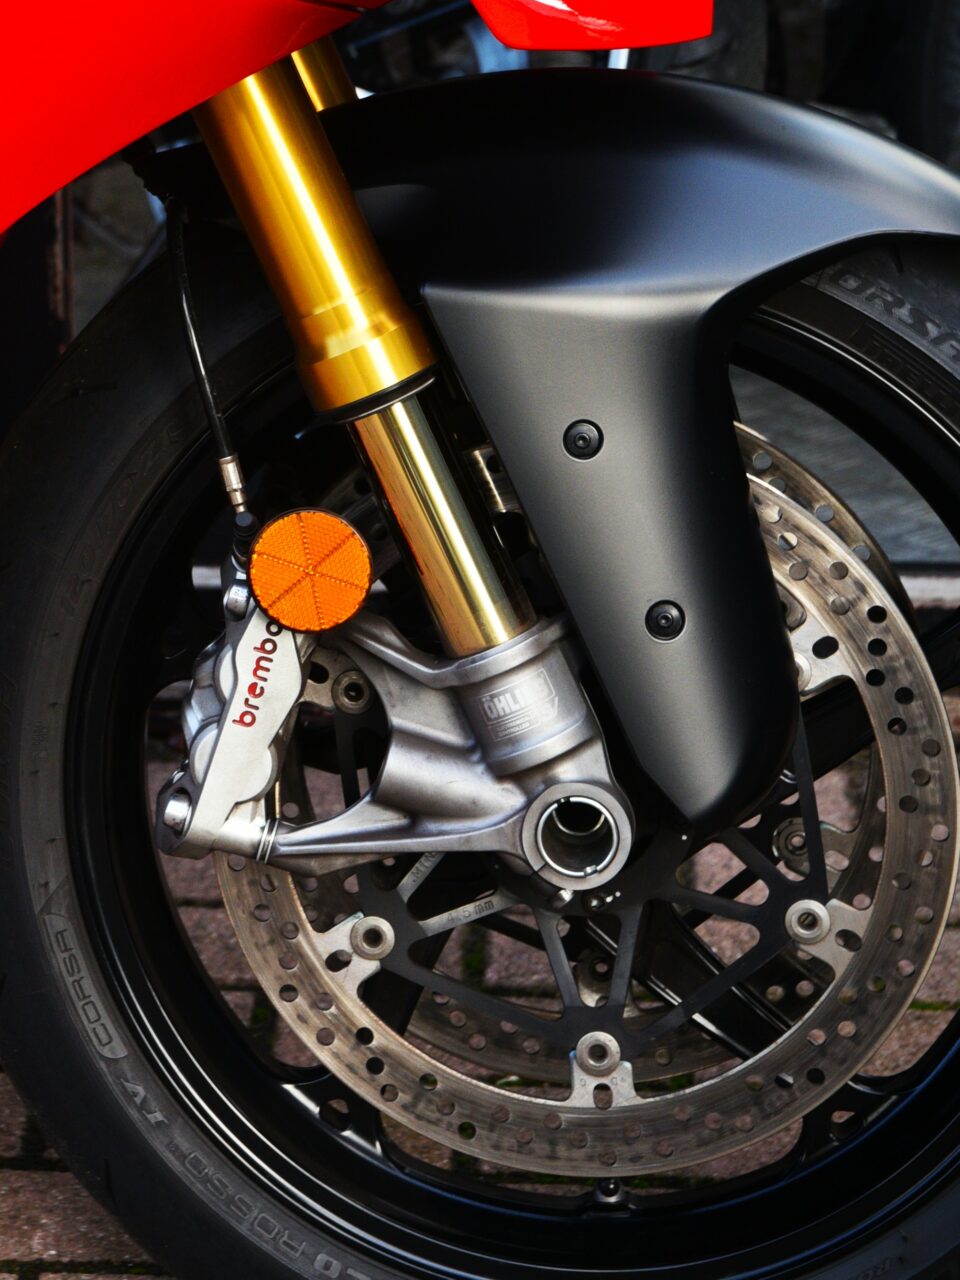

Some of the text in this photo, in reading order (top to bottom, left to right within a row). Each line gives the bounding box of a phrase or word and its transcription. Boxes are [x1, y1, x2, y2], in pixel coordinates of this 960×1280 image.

[232, 621, 283, 728] brembo
[481, 675, 550, 720] ÖHLI
[55, 928, 306, 1259] ROSSO IV CORSA
